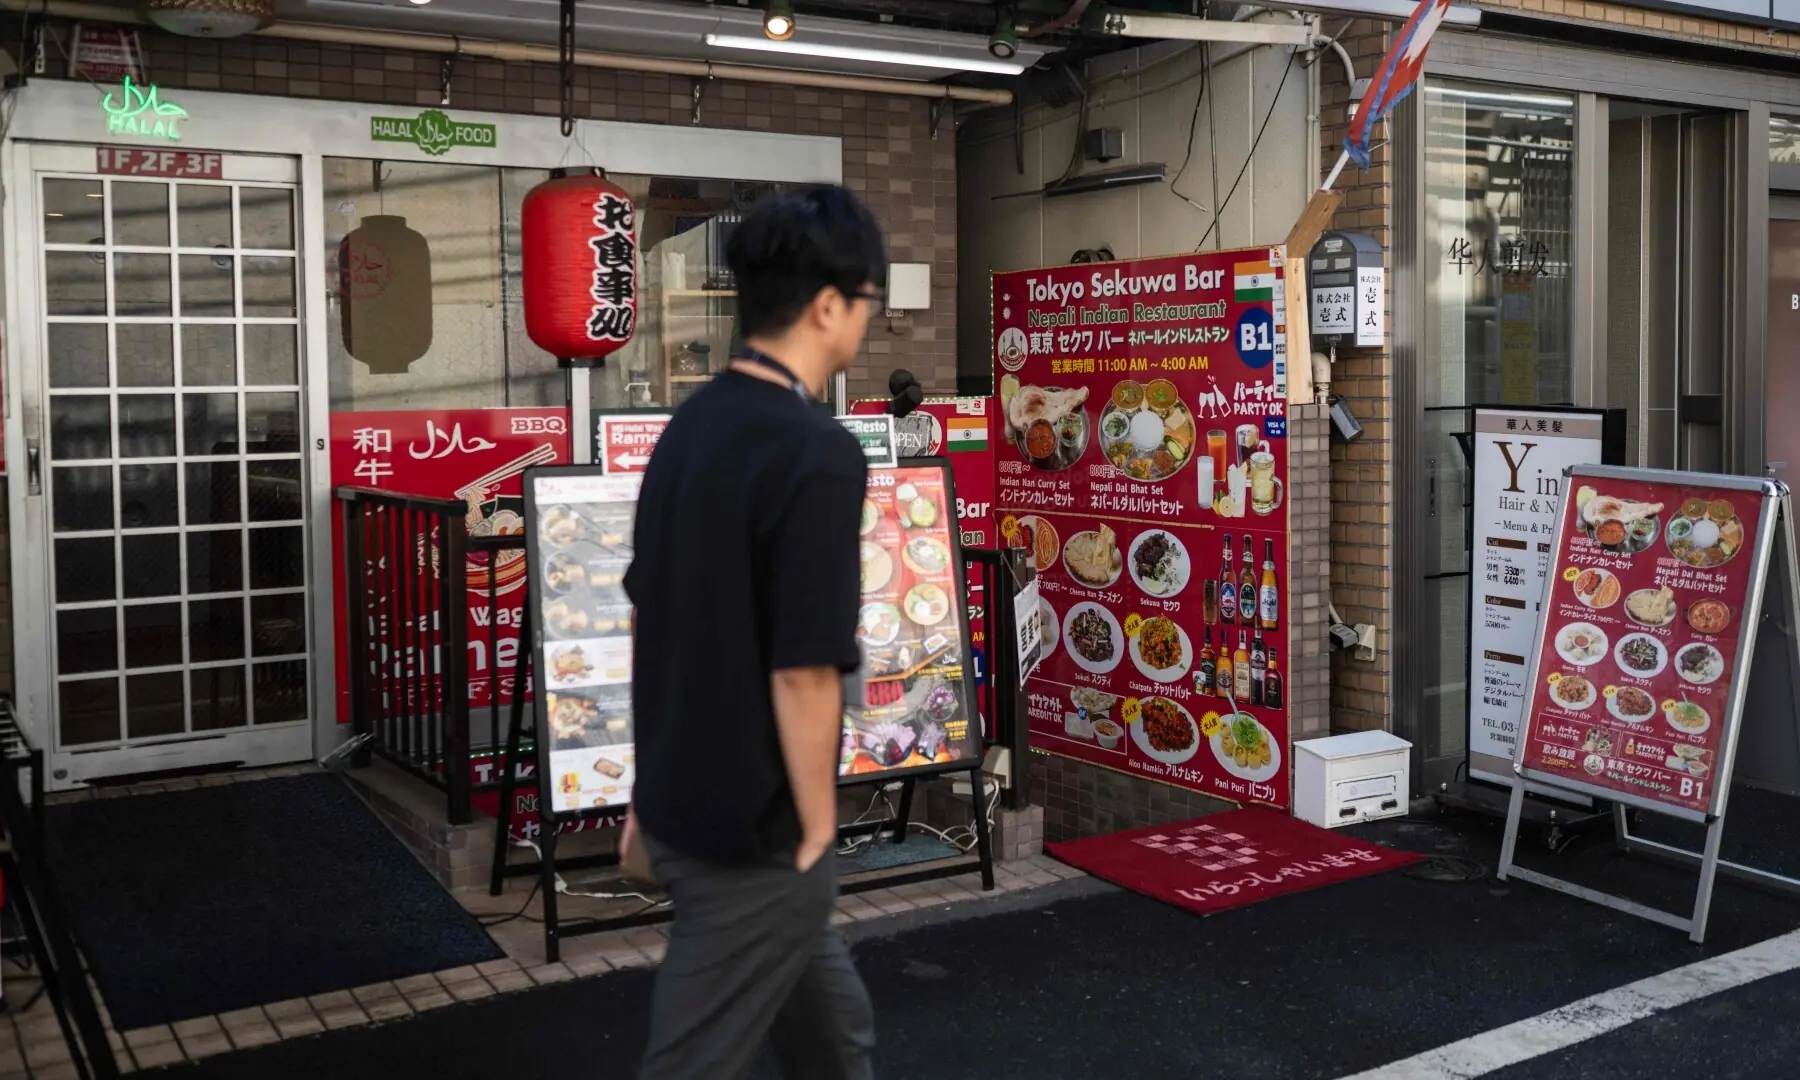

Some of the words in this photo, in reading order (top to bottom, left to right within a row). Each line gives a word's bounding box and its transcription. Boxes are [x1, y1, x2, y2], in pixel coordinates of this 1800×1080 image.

[108, 115, 181, 139] HALAL
[373, 120, 413, 137] HALAL
[456, 127, 492, 143] FOOD
[97, 149, 219, 176] 1F,2F,3F
[1027, 275, 1084, 305] Tokyo
[1091, 269, 1176, 298] Sekuwa
[1185, 264, 1225, 290] Bar
[1316, 293, 1351, 304] 株式会社
[1028, 307, 1076, 330] Nepali
[1080, 303, 1129, 325] Indian
[1133, 299, 1227, 321] Restaurant
[1029, 331, 1053, 355] 東京
[1058, 331, 1093, 354] セクワ
[1097, 330, 1124, 351] バー
[1240, 322, 1273, 351] B1
[1051, 358, 1094, 374] 営業時間
[1098, 359, 1127, 372] 11:00
[1129, 358, 1147, 370] AM
[1161, 357, 1186, 370] 4:00
[1189, 356, 1209, 370] AM
[1233, 402, 1268, 416] PARTY
[1269, 402, 1283, 416] OK
[512, 417, 566, 434] BBQ
[855, 420, 886, 433] Resto
[408, 420, 497, 459] حلال
[353, 427, 393, 485] 和牛
[1000, 477, 1019, 486] Indian
[1022, 478, 1035, 487] Nan
[1038, 479, 1056, 490] Curry
[1059, 481, 1070, 490] Set
[1090, 482, 1113, 493] Nepali
[1115, 483, 1128, 493] Dal
[1131, 484, 1148, 494] Bhat
[1151, 485, 1164, 496] Set
[956, 498, 989, 518] Bar
[1499, 496, 1525, 511] Hair
[1530, 499, 1540, 513] &
[1503, 520, 1528, 532] Menu
[1531, 523, 1539, 533] &
[1542, 524, 1553, 535] Pr
[1487, 538, 1499, 546] Cut
[1569, 544, 1588, 553] Indian
[1603, 549, 1619, 559] Curry
[1621, 550, 1631, 558] Set
[1486, 563, 1499, 572] 男性
[1656, 566, 1679, 577] Nepali
[1682, 570, 1693, 578] Dal
[1696, 572, 1712, 581] Bhat
[1716, 574, 1727, 582] Set
[1486, 573, 1499, 583] 女性
[1070, 588, 1086, 597] Cheese
[1486, 596, 1502, 604] Color
[1140, 598, 1160, 607] Sekuwa
[1162, 600, 1181, 611] セクワ
[1129, 681, 1153, 693] Chatpate
[1053, 713, 1062, 723] OK
[1607, 760, 1624, 772] 東京
[1626, 764, 1651, 776] セクワ
[1653, 770, 1671, 781] バー
[1215, 778, 1229, 790] Pani
[1231, 781, 1245, 793] Puri
[1679, 777, 1704, 799] B1
[1176, 848, 1381, 901] いらっしゃいませ
